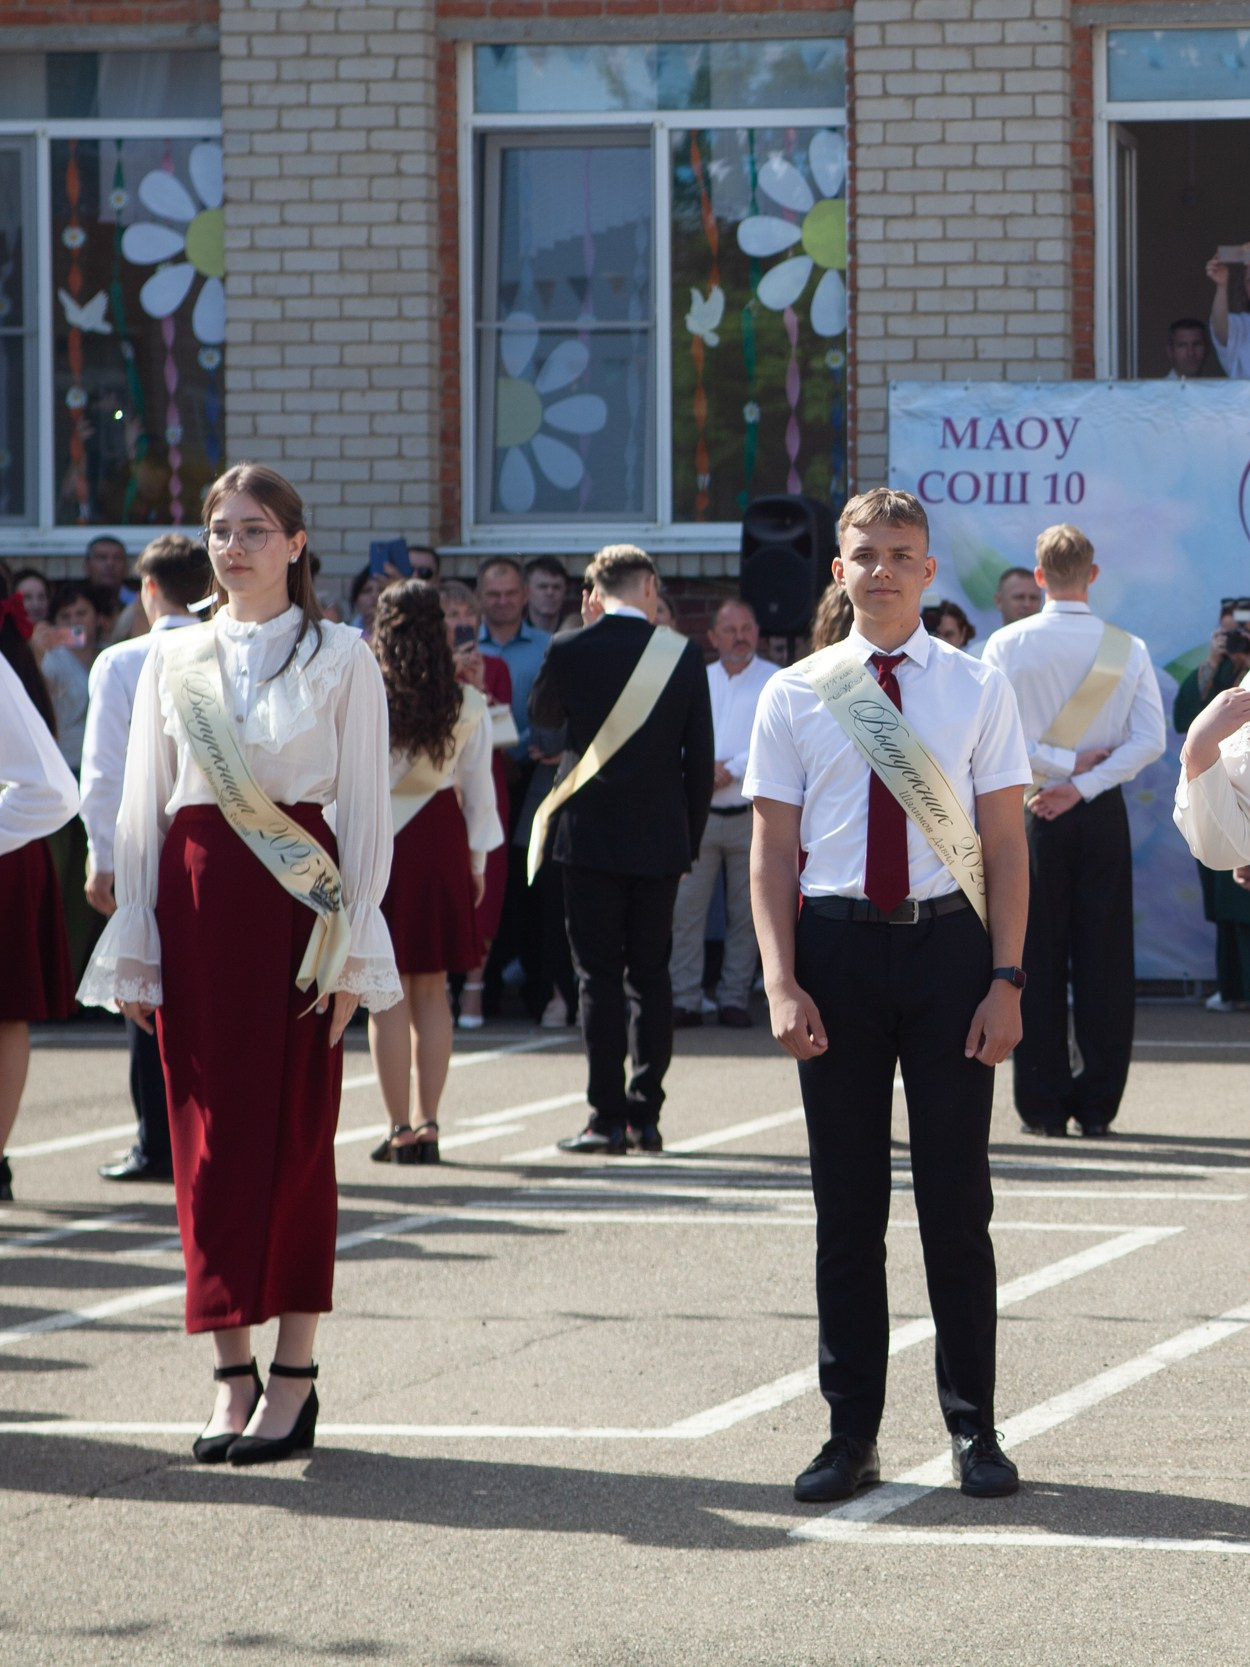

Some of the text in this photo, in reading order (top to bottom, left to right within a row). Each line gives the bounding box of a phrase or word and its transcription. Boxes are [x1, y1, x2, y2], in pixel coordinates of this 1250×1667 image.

[939, 416, 1082, 460] МАОУ
[917, 470, 1085, 505] СОШ 10
[180, 670, 256, 815] Выпускница
[257, 821, 320, 876] 2025
[848, 699, 954, 828] Выпускник
